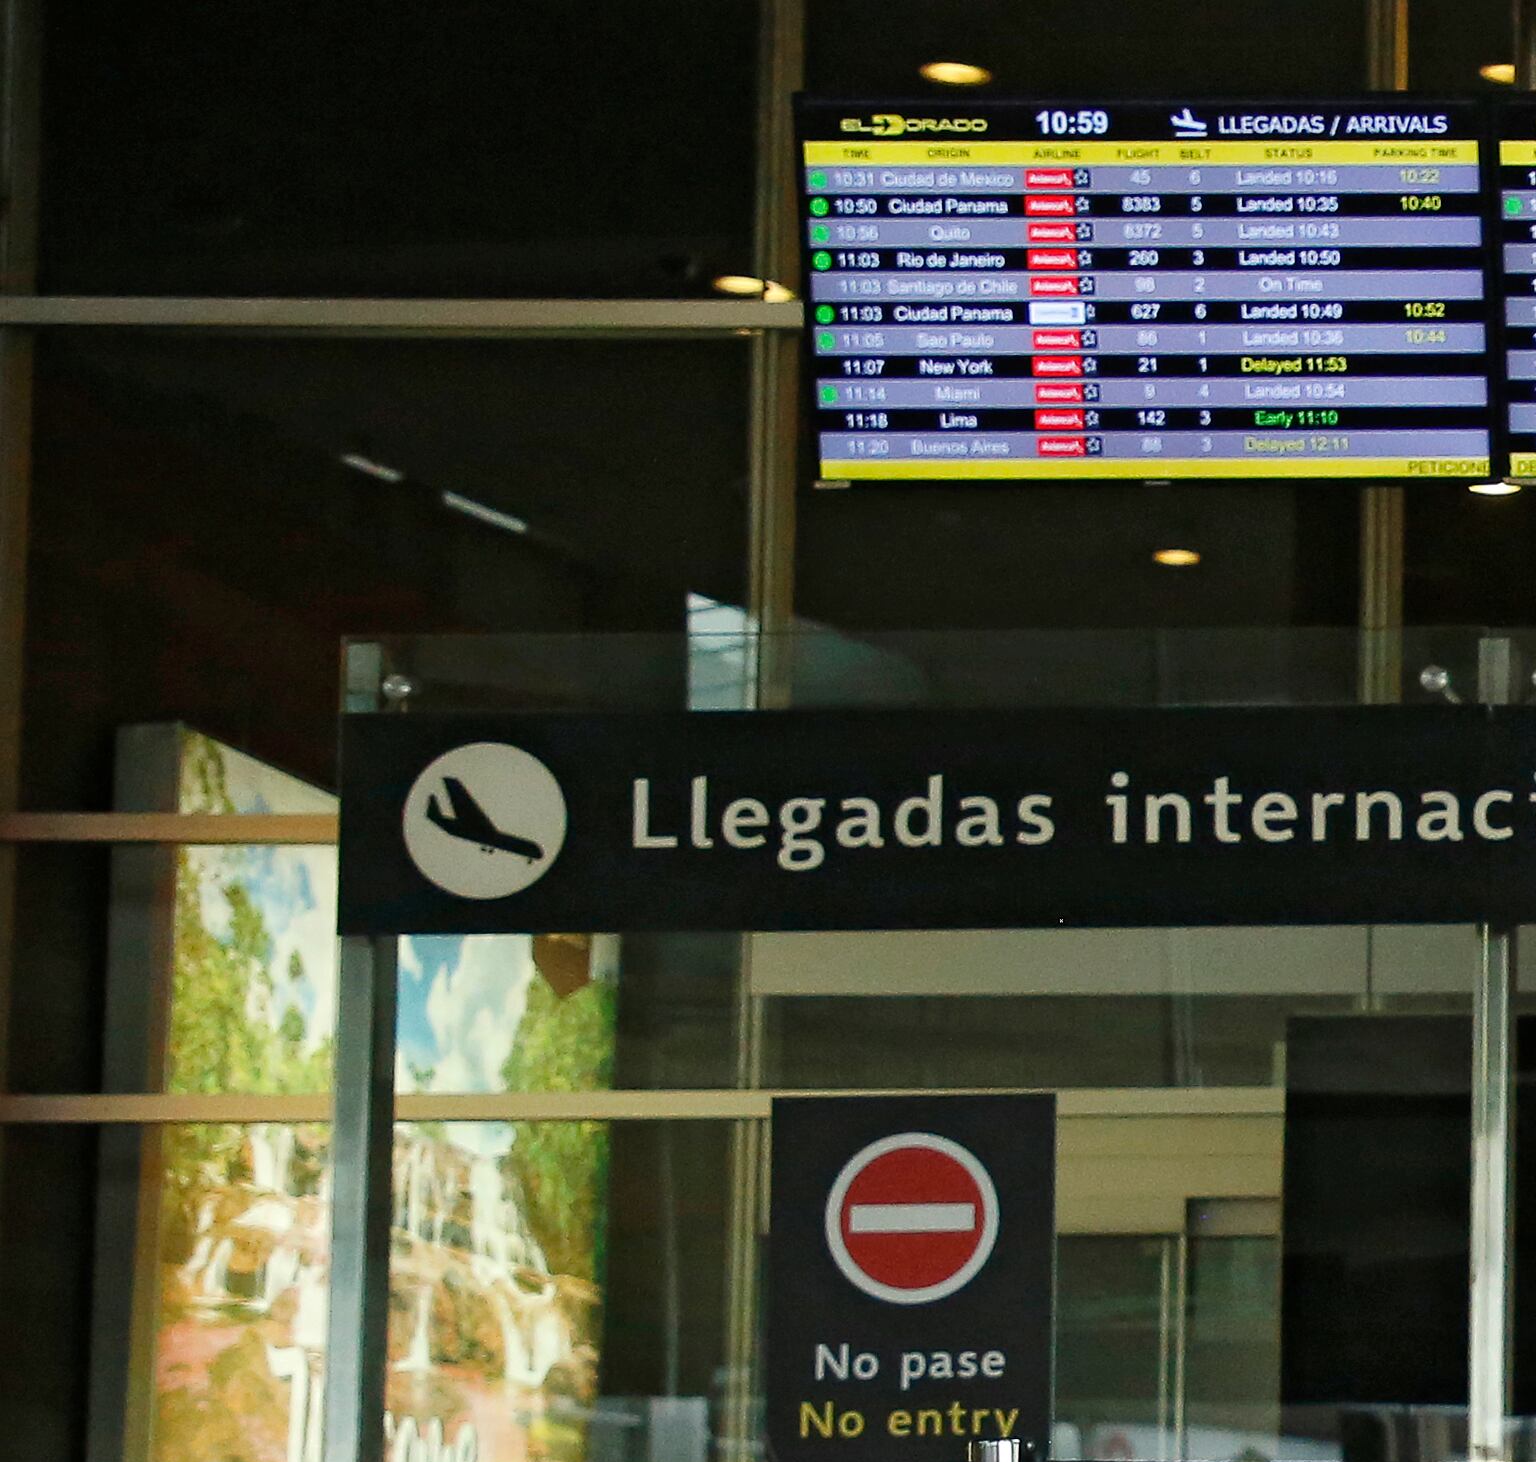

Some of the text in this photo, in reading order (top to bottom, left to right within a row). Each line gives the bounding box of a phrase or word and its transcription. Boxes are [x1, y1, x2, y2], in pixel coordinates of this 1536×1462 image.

[1036, 111, 1108, 134] 10:59
[1219, 116, 1325, 133] LLEGADAS
[1346, 115, 1447, 133] ARRIVALS
[888, 198, 942, 214] Ciudad
[948, 198, 1008, 214] Panama
[1237, 197, 1293, 212] Landed
[1399, 192, 1443, 210] 10:40
[897, 252, 924, 268] Rio
[926, 253, 946, 268] de
[949, 253, 1005, 268] Janeiro
[1239, 250, 1295, 265] Landed
[894, 306, 950, 321] Ciudad
[953, 306, 1013, 321] Panama
[1241, 304, 1297, 319] Landed
[1405, 303, 1445, 317] 10:52
[844, 357, 1347, 375] 11:07 New York 21 Delayed 11:53
[940, 413, 977, 428] Lima
[1255, 411, 1293, 428] Early
[1517, 460, 1536, 473] DE
[633, 774, 1054, 871] Llegadas
[815, 1343, 1005, 1390] No pase
[800, 1401, 1018, 1438] No entry
